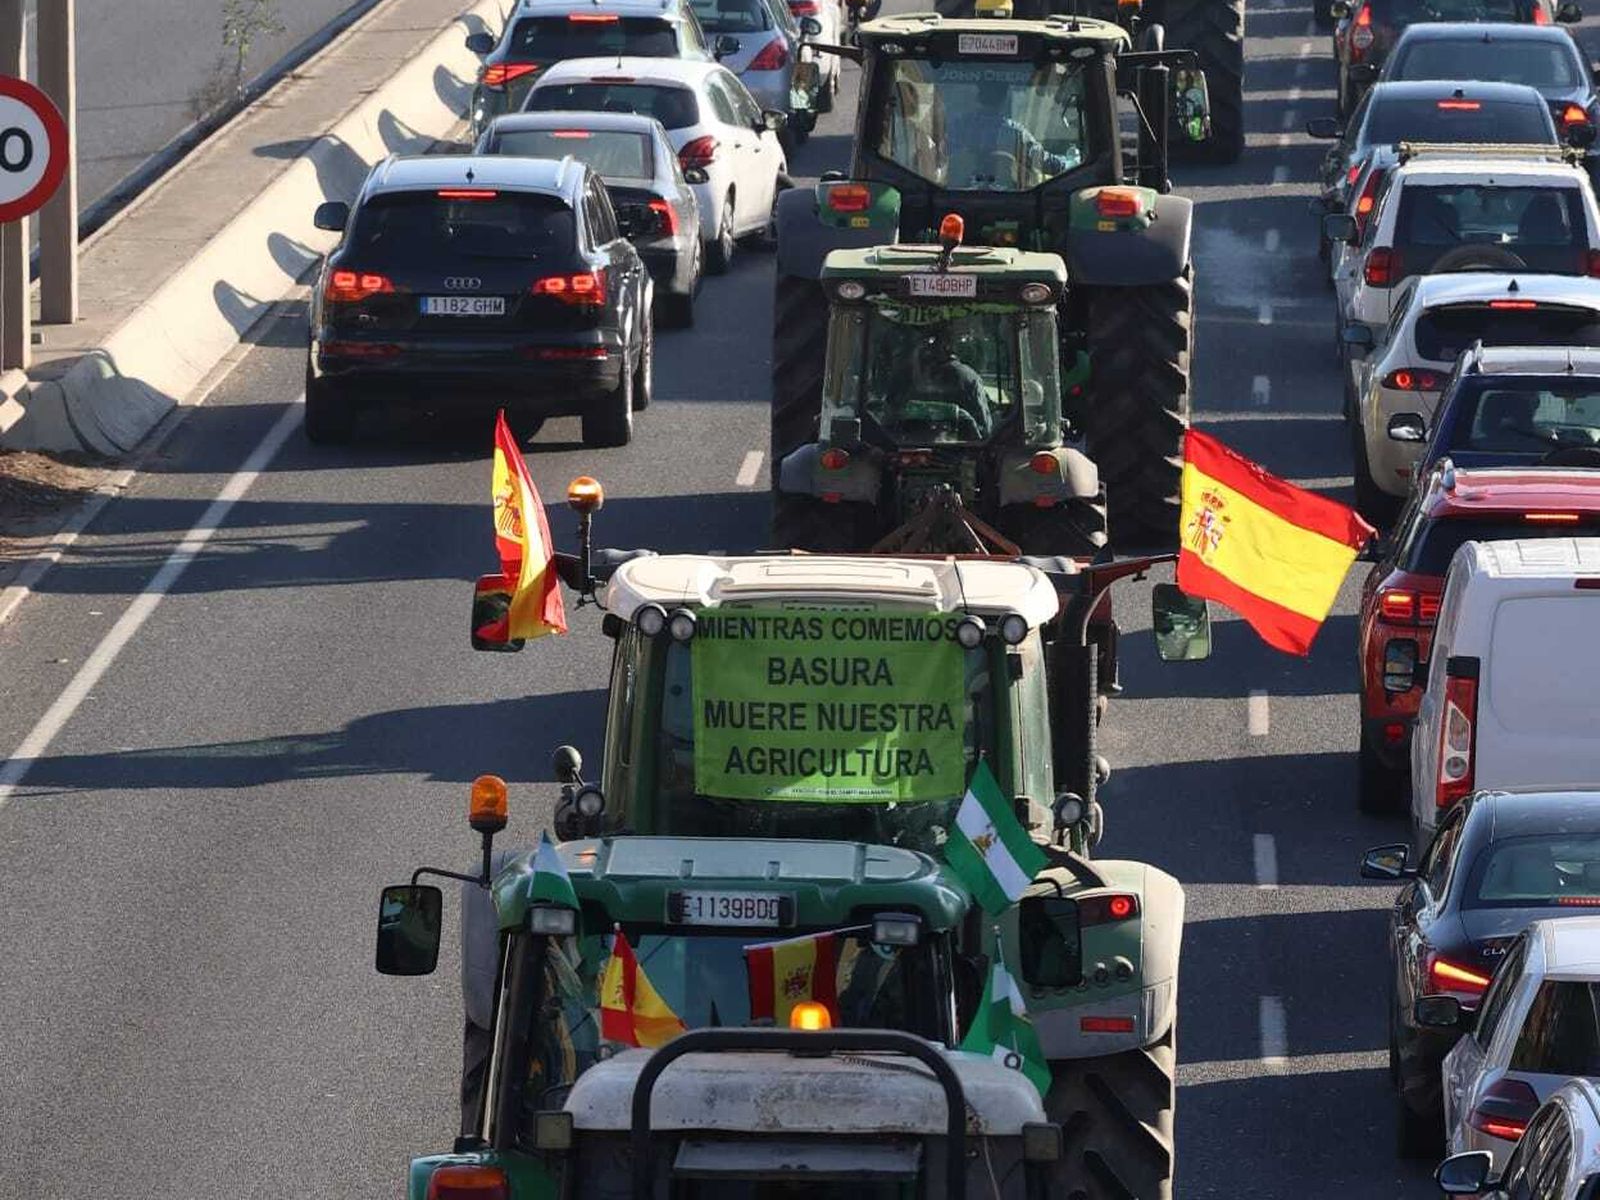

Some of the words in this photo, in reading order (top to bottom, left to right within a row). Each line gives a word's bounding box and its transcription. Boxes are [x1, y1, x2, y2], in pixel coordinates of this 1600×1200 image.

[432, 300, 470, 313] 1182
[473, 300, 503, 313] GHM
[696, 615, 823, 640] MIENTRAS
[831, 616, 957, 642] COMEMOS
[768, 657, 893, 687] BASURA
[704, 701, 807, 731] MUERE
[818, 702, 955, 733] NUESTRA
[724, 746, 934, 778] AGRICULTURA
